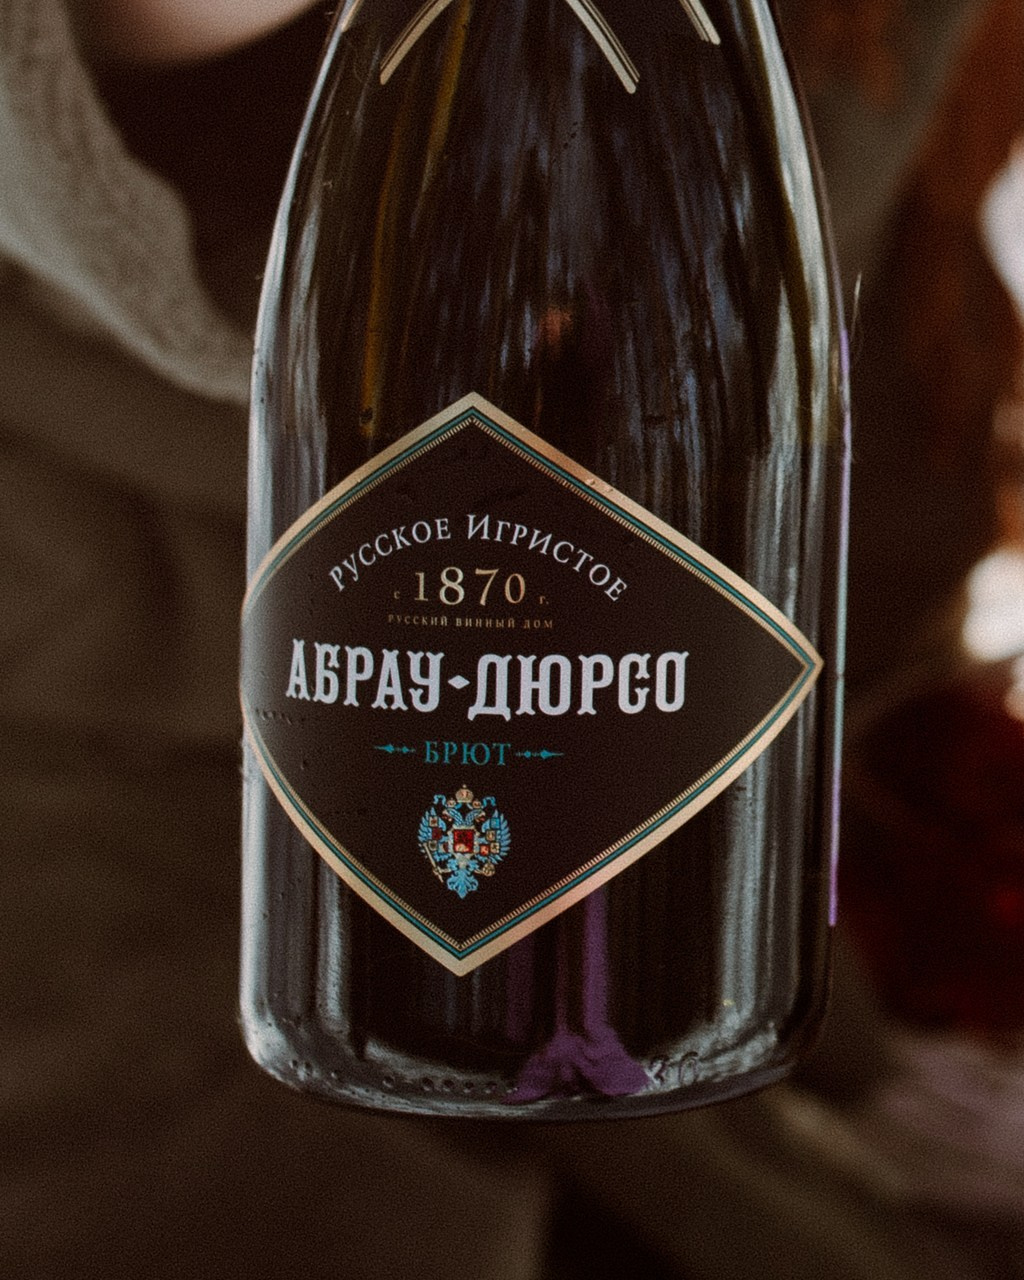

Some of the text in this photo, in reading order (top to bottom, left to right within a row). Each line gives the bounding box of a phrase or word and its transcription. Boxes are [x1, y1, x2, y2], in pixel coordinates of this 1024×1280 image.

[328, 514, 627, 601] РУССКОЕ ИГРИСТОЕ
[413, 566, 526, 606] 1870
[388, 614, 554, 629] РУССКИЙ ВИННЫЙ ДОМ
[424, 740, 512, 766] БРЮТ
